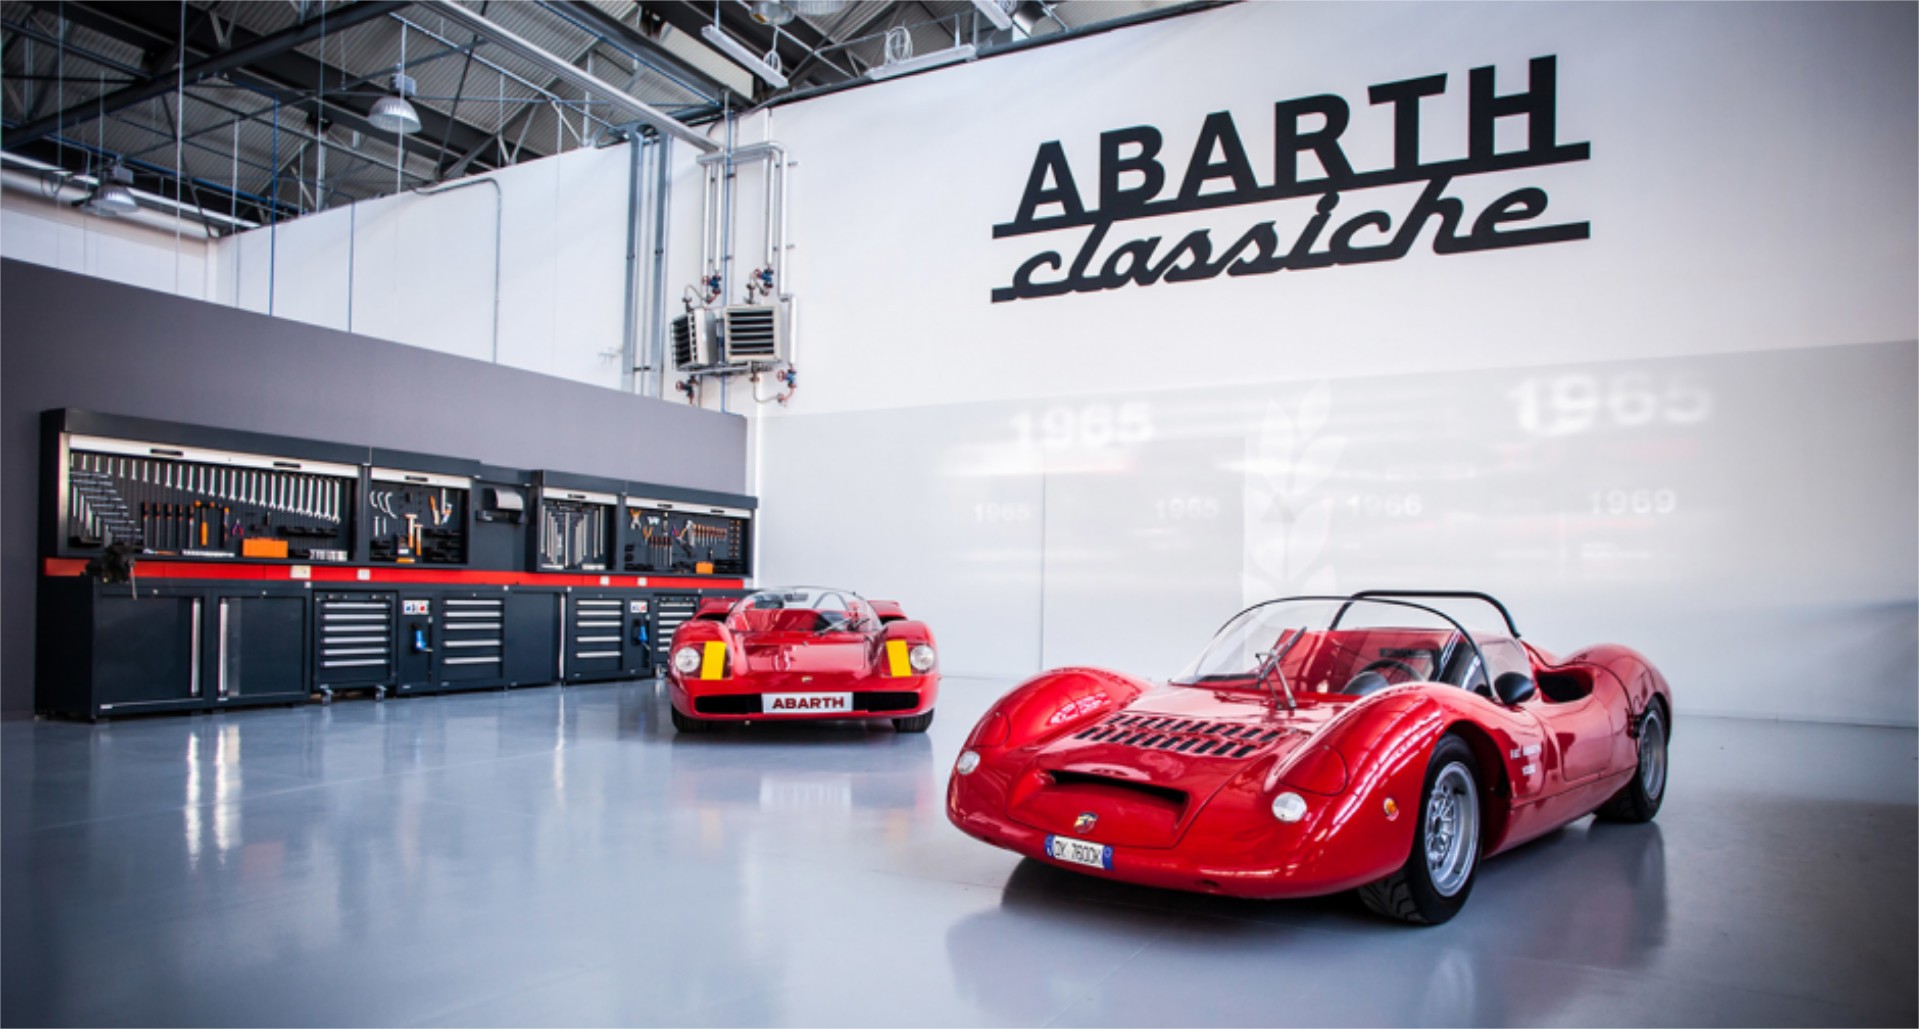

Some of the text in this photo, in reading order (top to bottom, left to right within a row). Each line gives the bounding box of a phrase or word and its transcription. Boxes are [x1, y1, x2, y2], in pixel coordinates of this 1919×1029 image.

[1008, 54, 1560, 226] ABARTH
[1010, 177, 1552, 300] classiche
[1010, 401, 1154, 448] 1965
[1587, 488, 1676, 514] 1969
[772, 697, 845, 710] ABARTH
